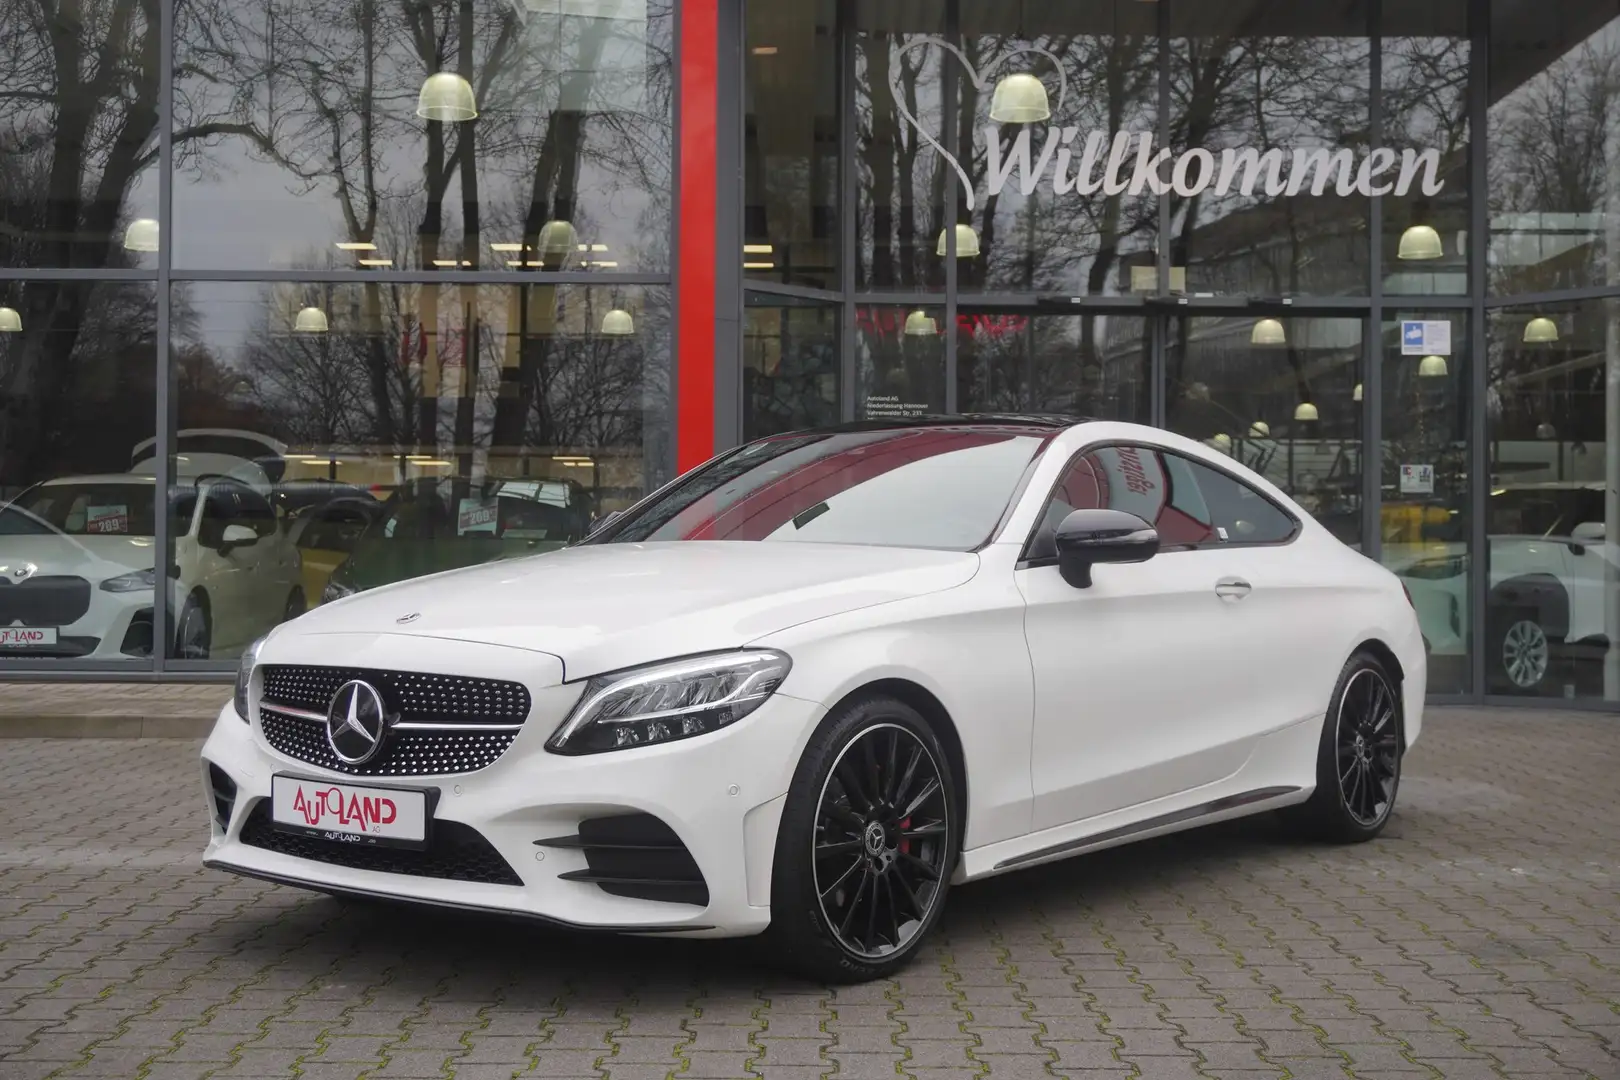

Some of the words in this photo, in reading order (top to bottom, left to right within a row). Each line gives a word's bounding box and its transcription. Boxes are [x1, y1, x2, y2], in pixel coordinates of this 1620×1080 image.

[984, 126, 1445, 197] Willkommen
[293, 784, 397, 832] AUTOLAND
[324, 831, 361, 843] AUTOLAND
[372, 825, 381, 834] AG
